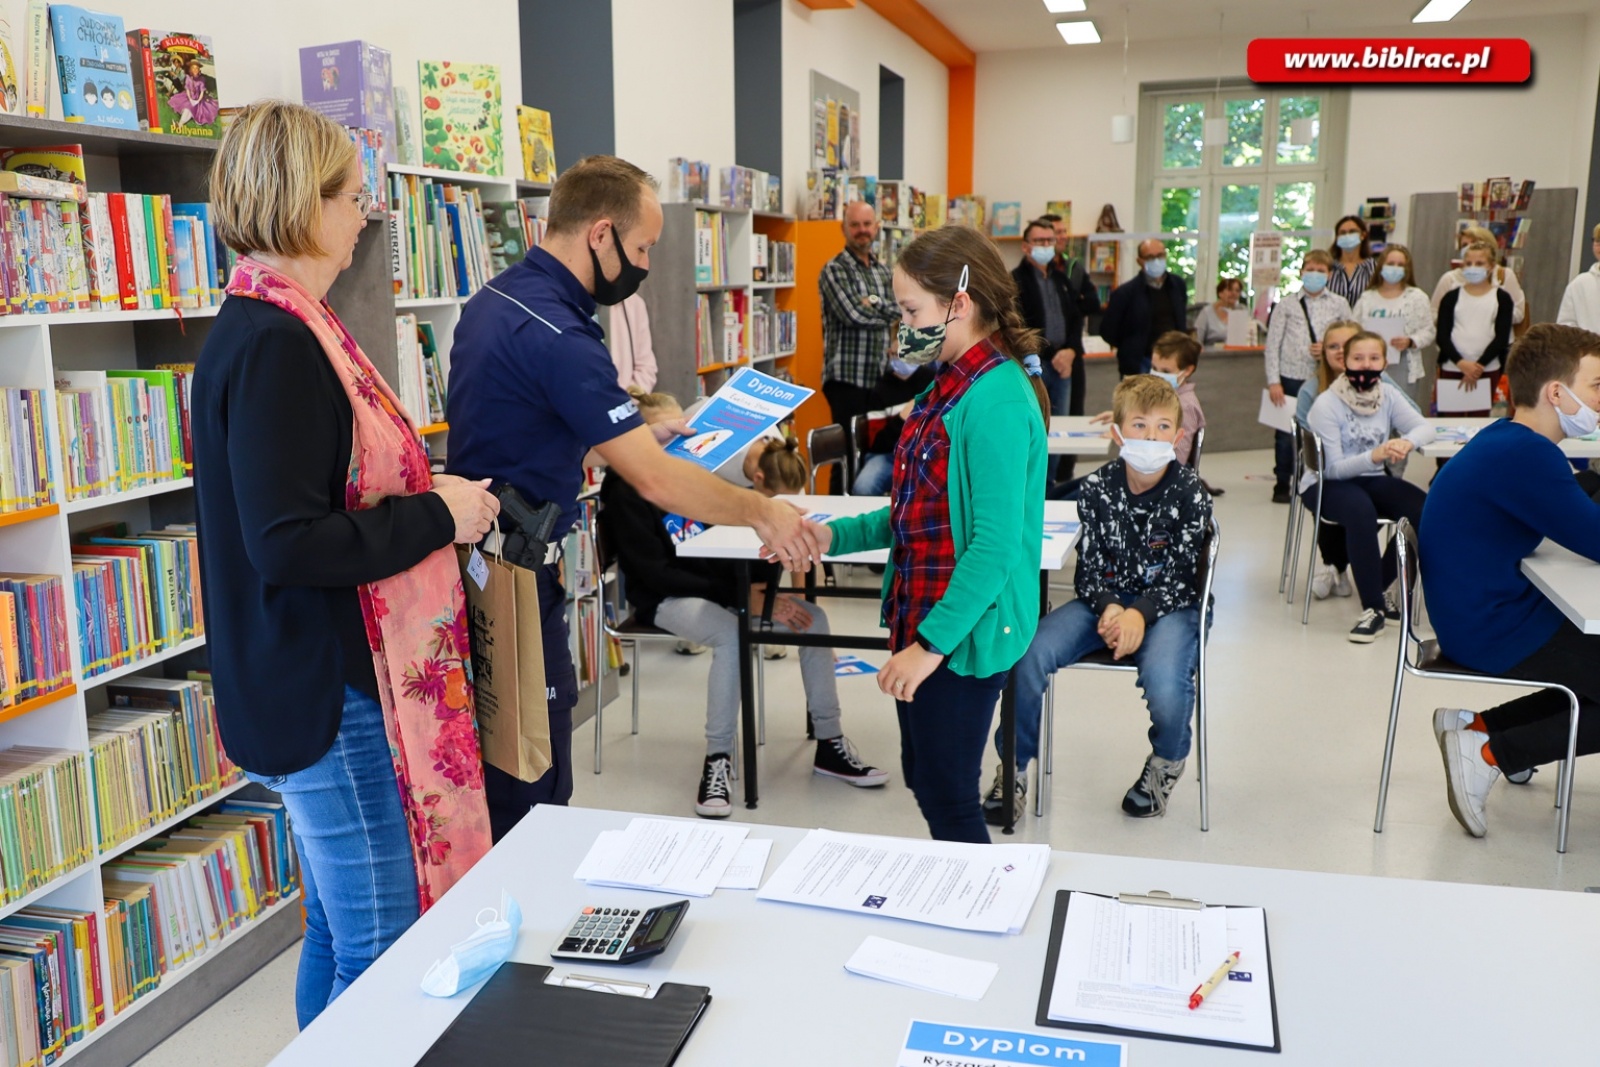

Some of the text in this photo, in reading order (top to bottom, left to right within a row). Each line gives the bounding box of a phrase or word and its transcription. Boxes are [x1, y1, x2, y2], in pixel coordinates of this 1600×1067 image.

[165, 37, 200, 50] KLASYKA
[170, 124, 214, 137] Pollyanna
[747, 377, 795, 402] Dyplom
[942, 1031, 1087, 1062] Dyplom
